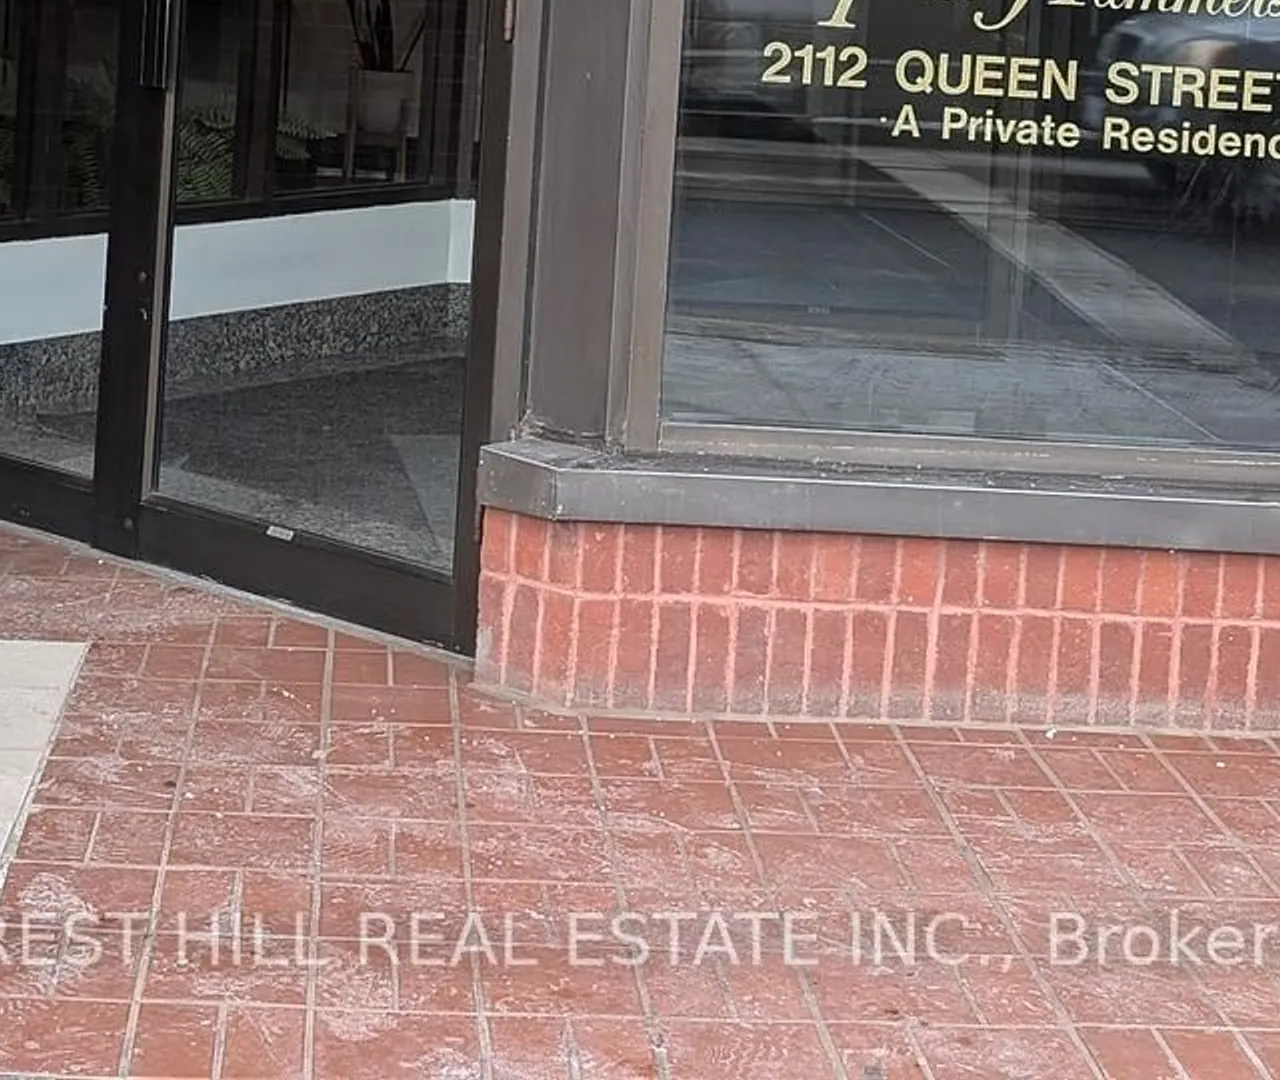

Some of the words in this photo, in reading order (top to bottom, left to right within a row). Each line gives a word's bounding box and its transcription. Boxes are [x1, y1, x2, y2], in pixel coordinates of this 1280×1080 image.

[760, 41, 868, 88] 2112
[894, 49, 1078, 101] QUEEN
[891, 103, 921, 138] A
[941, 106, 1081, 147] Private
